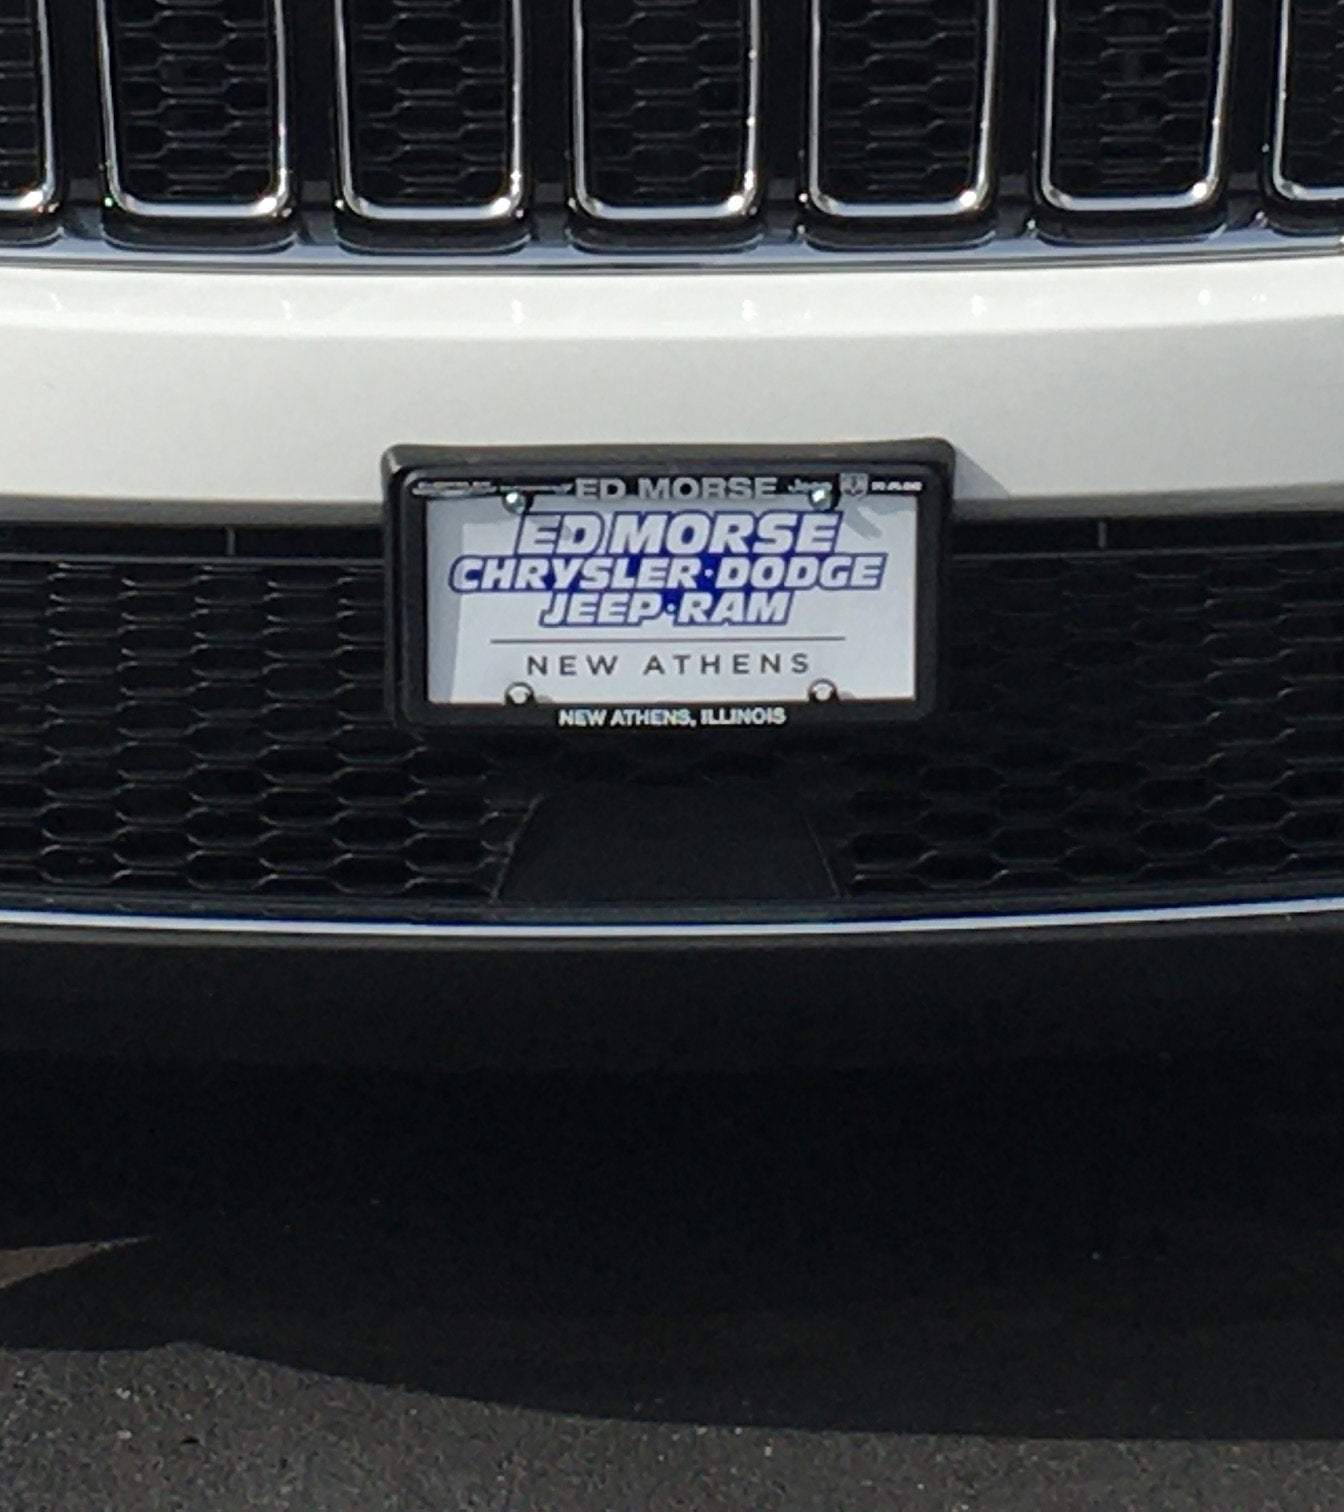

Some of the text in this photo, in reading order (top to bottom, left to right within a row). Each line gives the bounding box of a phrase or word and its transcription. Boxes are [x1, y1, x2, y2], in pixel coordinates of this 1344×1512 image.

[575, 477, 626, 500] ED
[638, 476, 778, 500] MORSE
[514, 509, 843, 555] ED MORSE
[527, 653, 809, 676] NEW ATHENS
[558, 707, 787, 727] NEW ATHENS, ILLINOIS
